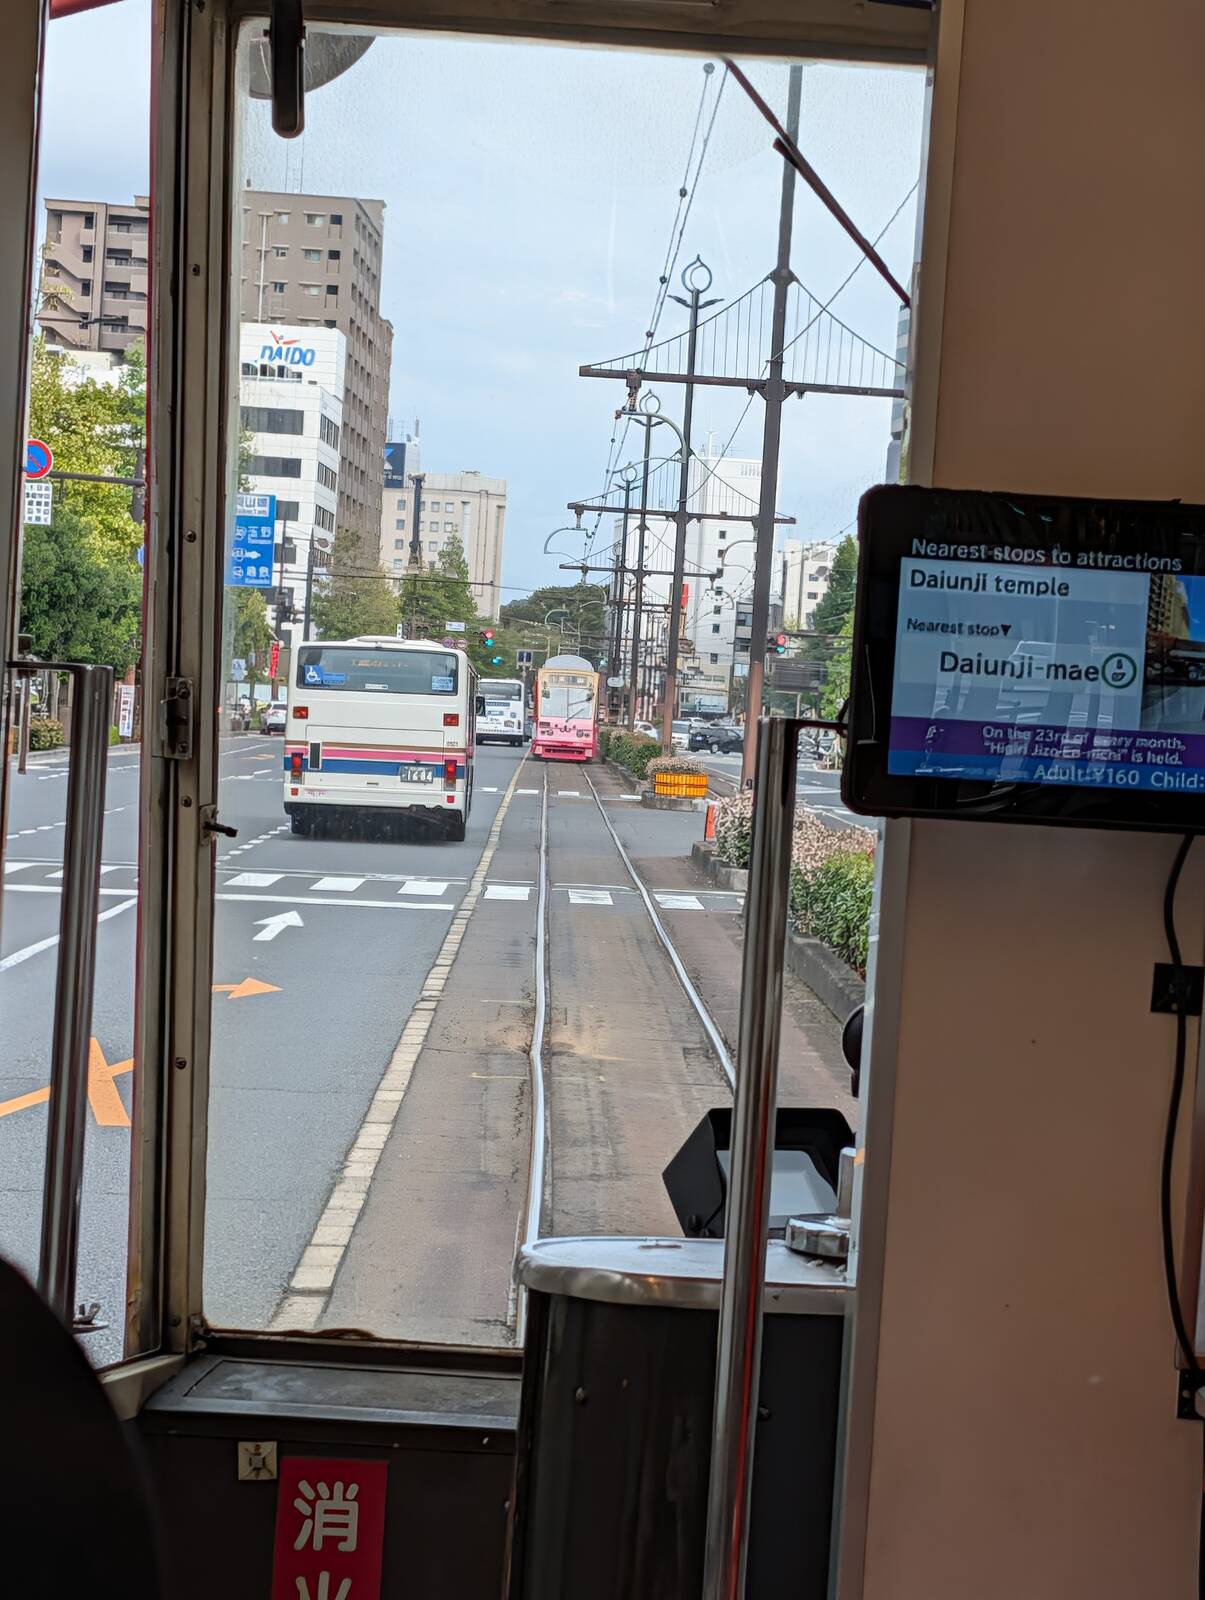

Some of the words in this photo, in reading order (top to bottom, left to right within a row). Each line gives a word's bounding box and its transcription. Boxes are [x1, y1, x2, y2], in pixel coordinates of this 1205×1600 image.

[911, 537, 987, 559] Nearest
[993, 545, 1046, 563] stops
[1052, 547, 1071, 564] to
[1077, 551, 1182, 571] attractions
[911, 569, 987, 592] Daiunji
[995, 575, 1070, 597] temple
[907, 617, 963, 635] Nearest
[967, 622, 1000, 637] stop
[940, 650, 1100, 682] Daiunji-mae
[982, 725, 1003, 738] On
[1094, 734, 1134, 748] ery
[1151, 770, 1205, 789] Child:
